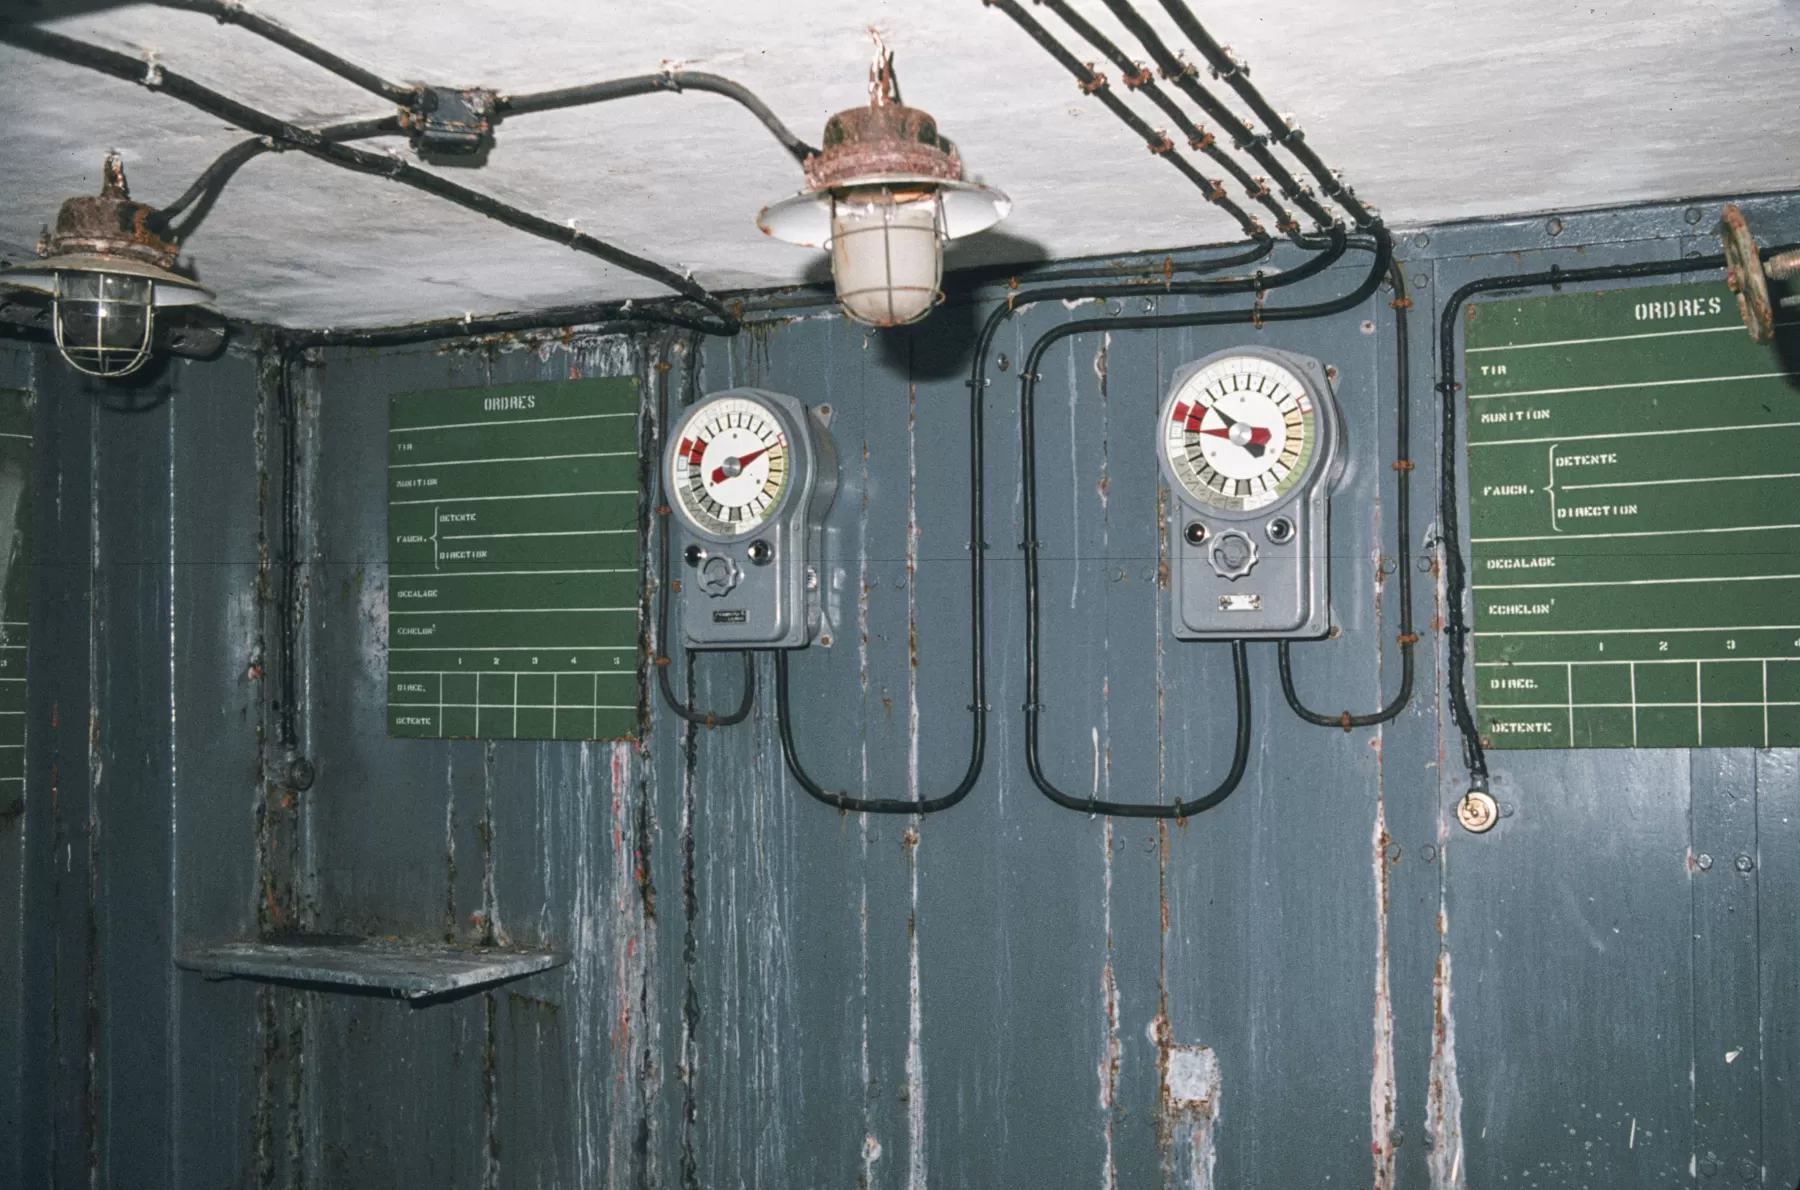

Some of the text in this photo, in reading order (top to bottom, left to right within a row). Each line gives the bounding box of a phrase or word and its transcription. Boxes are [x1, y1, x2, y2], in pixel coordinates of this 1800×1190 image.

[1634, 297, 1721, 321] ORDRES
[1480, 365, 1507, 376] TIR
[484, 396, 536, 411] ORDRES
[1481, 410, 1551, 424] MUNITION
[1555, 453, 1618, 467] DETENTE
[1483, 485, 1535, 497] FAUCH.
[1557, 504, 1638, 519] DIRECTION
[1486, 557, 1556, 570] DECALAGE
[1599, 642, 1604, 652] 1
[1658, 641, 1668, 651] 2
[1726, 640, 1736, 650] 3
[531, 657, 539, 665] 3
[570, 657, 577, 665] 4
[613, 657, 621, 665] 5
[1490, 679, 1538, 689] DIREC.
[1491, 723, 1552, 733] DETENTE
